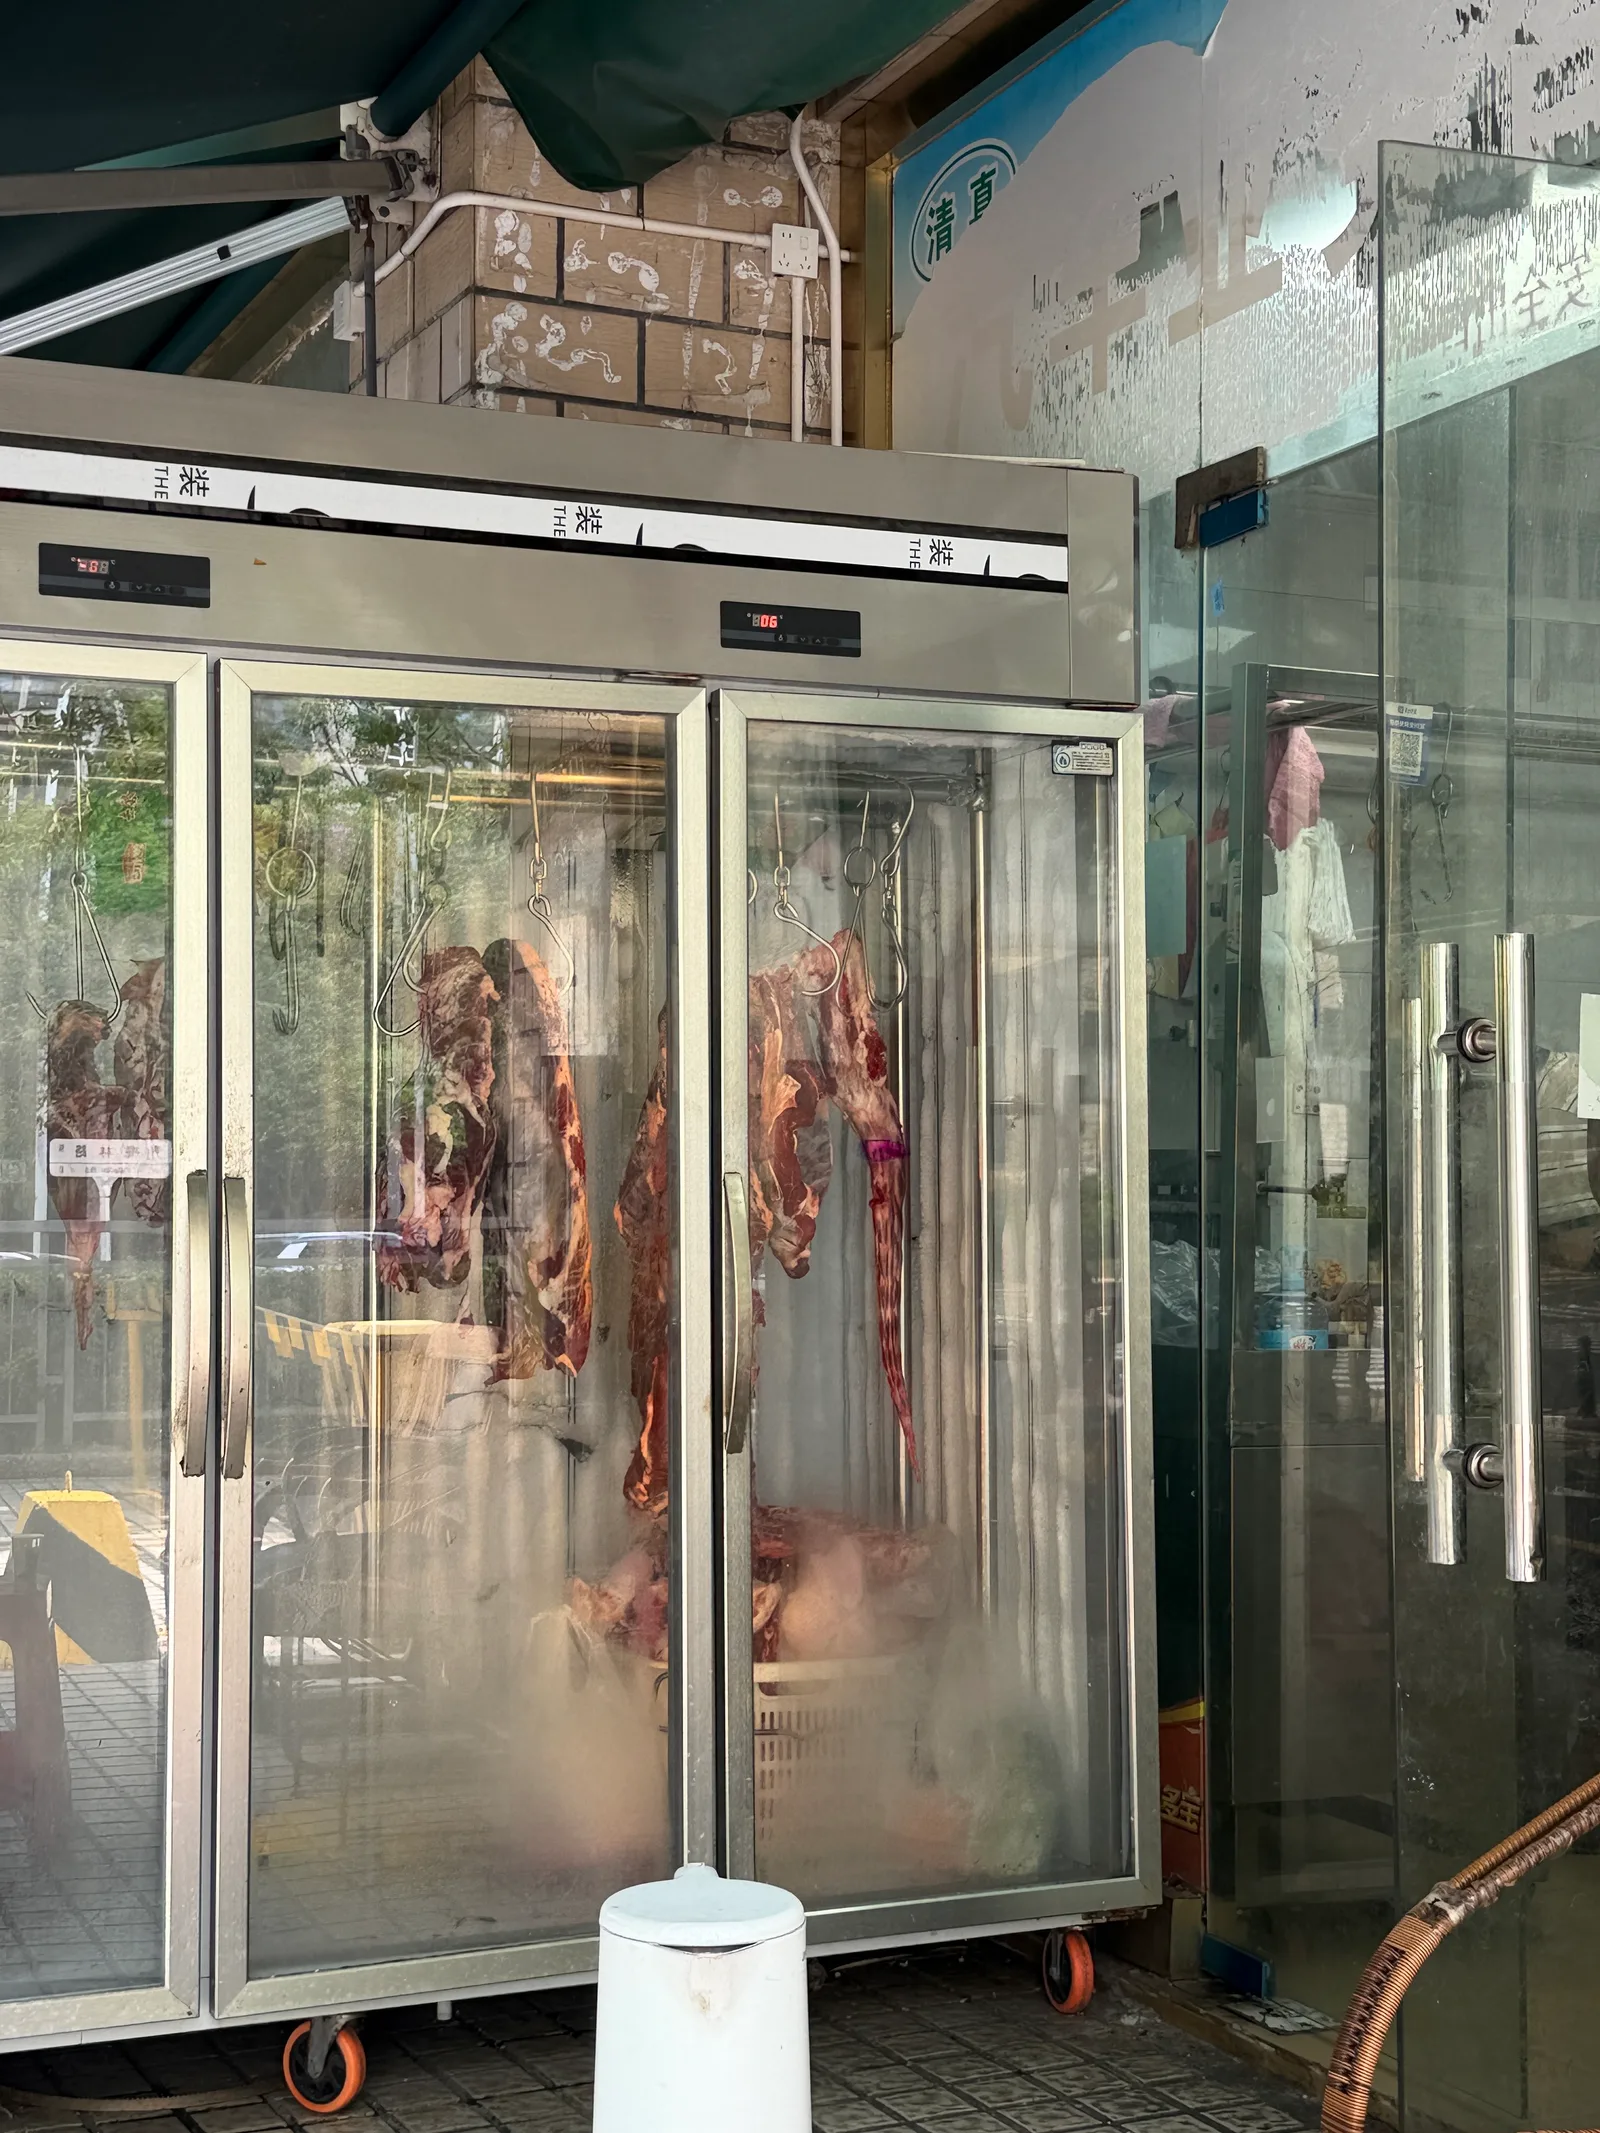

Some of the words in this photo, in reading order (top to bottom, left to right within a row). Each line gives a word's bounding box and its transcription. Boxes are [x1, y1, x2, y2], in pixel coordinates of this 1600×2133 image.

[154, 466, 169, 500] THE
[179, 466, 209, 497] 装
[553, 505, 566, 537] THE
[575, 505, 602, 534] 装
[909, 538, 921, 569] THE
[929, 538, 953, 566] 装
